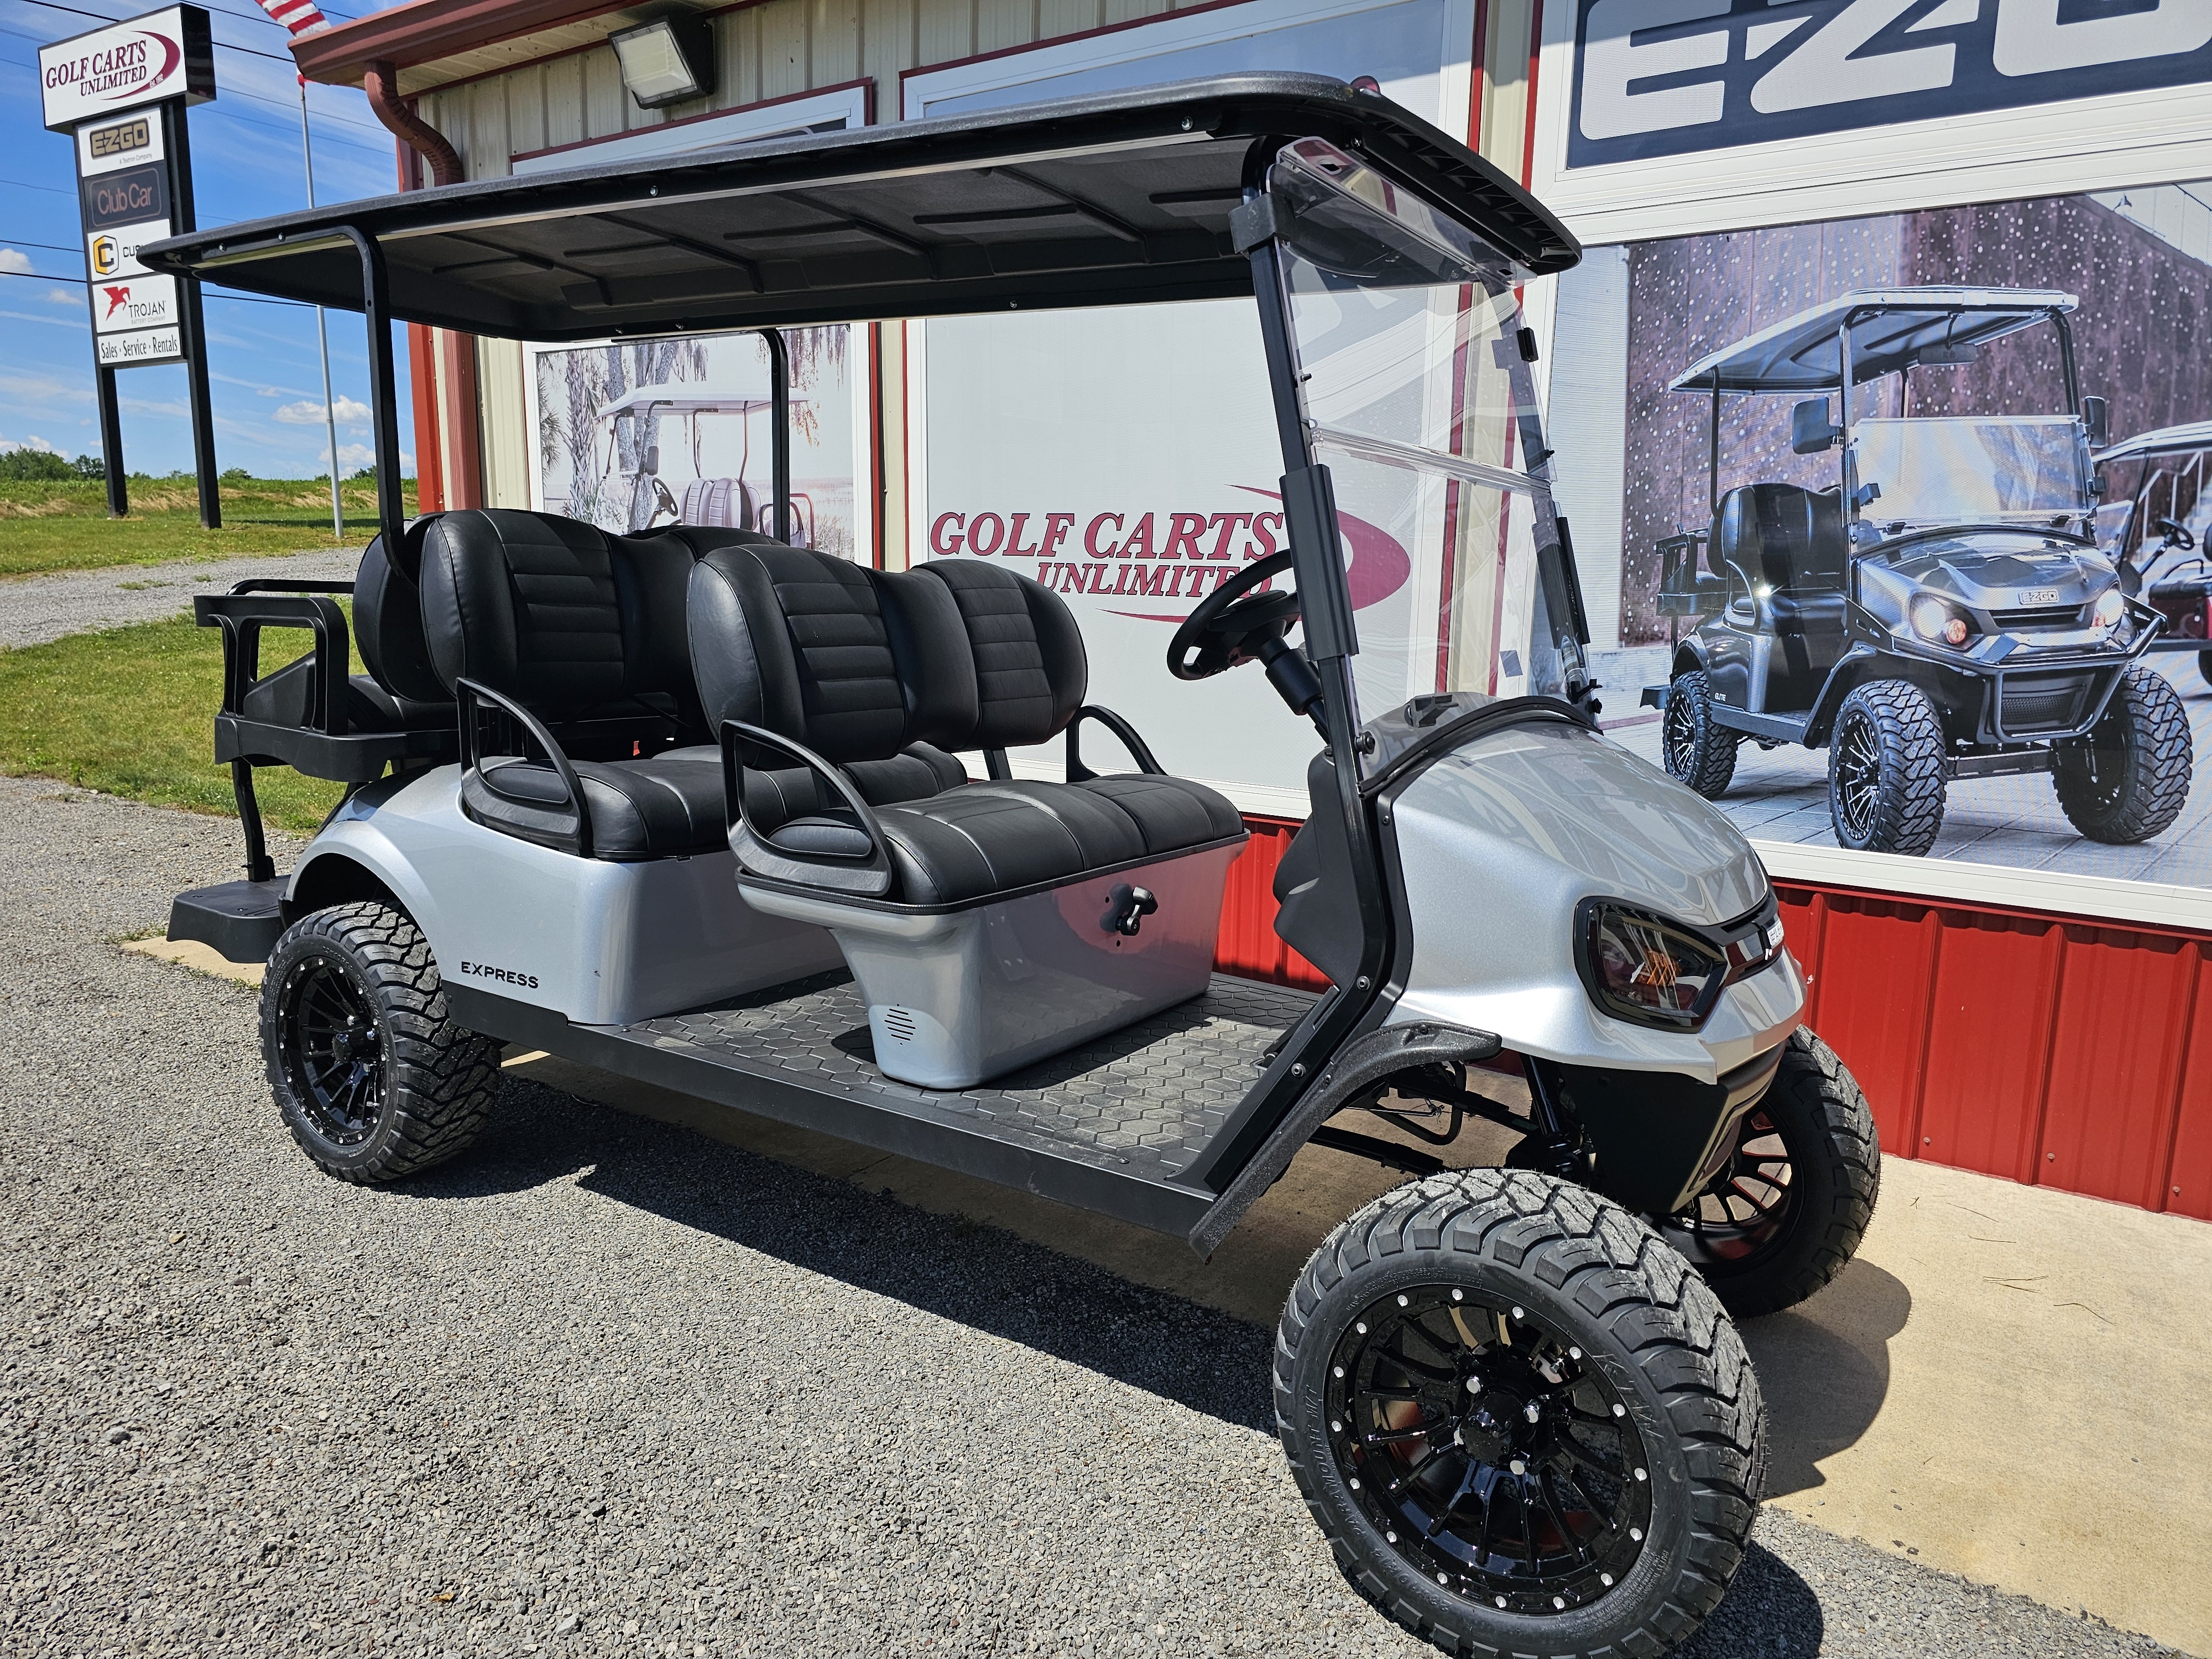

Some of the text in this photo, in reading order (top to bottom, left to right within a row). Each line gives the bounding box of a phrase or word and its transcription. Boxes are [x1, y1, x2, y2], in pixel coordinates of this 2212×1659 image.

[46, 39, 147, 89] GOLF CARTS
[80, 65, 147, 97] UNLIMITED
[91, 122, 149, 156] EZGO
[97, 183, 152, 215] Club Car
[128, 300, 165, 318] TROJAN
[101, 335, 178, 359] Sales Service Rentals
[930, 512, 1284, 561] GOLF CARTS
[2022, 590, 2058, 603] EZGO
[461, 961, 539, 989] EXPRESS
